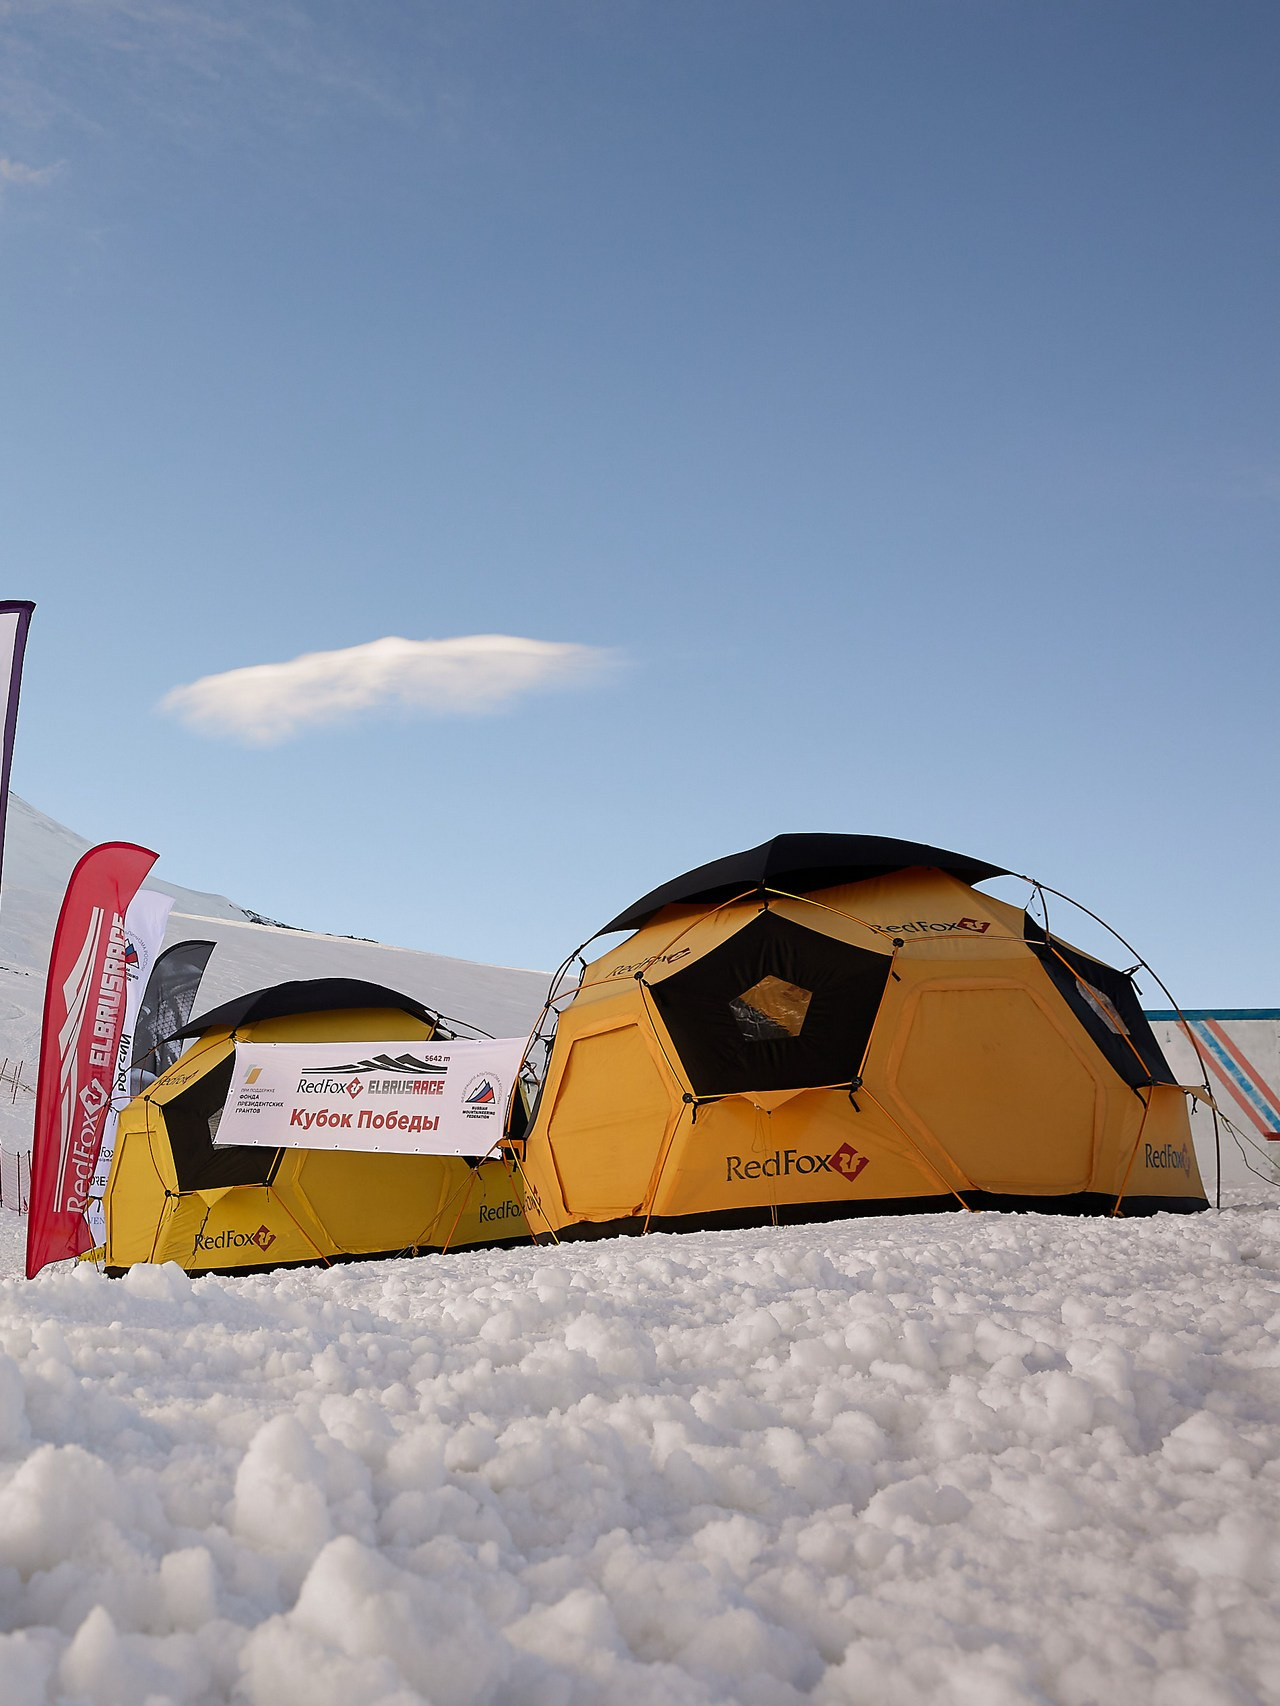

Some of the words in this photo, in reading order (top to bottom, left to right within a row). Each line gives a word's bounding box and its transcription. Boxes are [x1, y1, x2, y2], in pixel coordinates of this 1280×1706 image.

[296, 1079, 347, 1094] RedFox
[367, 1080, 446, 1096] ELBRUSRACE
[289, 1108, 353, 1130] Кубок
[357, 1110, 440, 1133] Победы
[726, 1149, 833, 1182] RedFox
[1145, 1143, 1183, 1169] RedFox
[195, 1230, 255, 1250] RedFox
